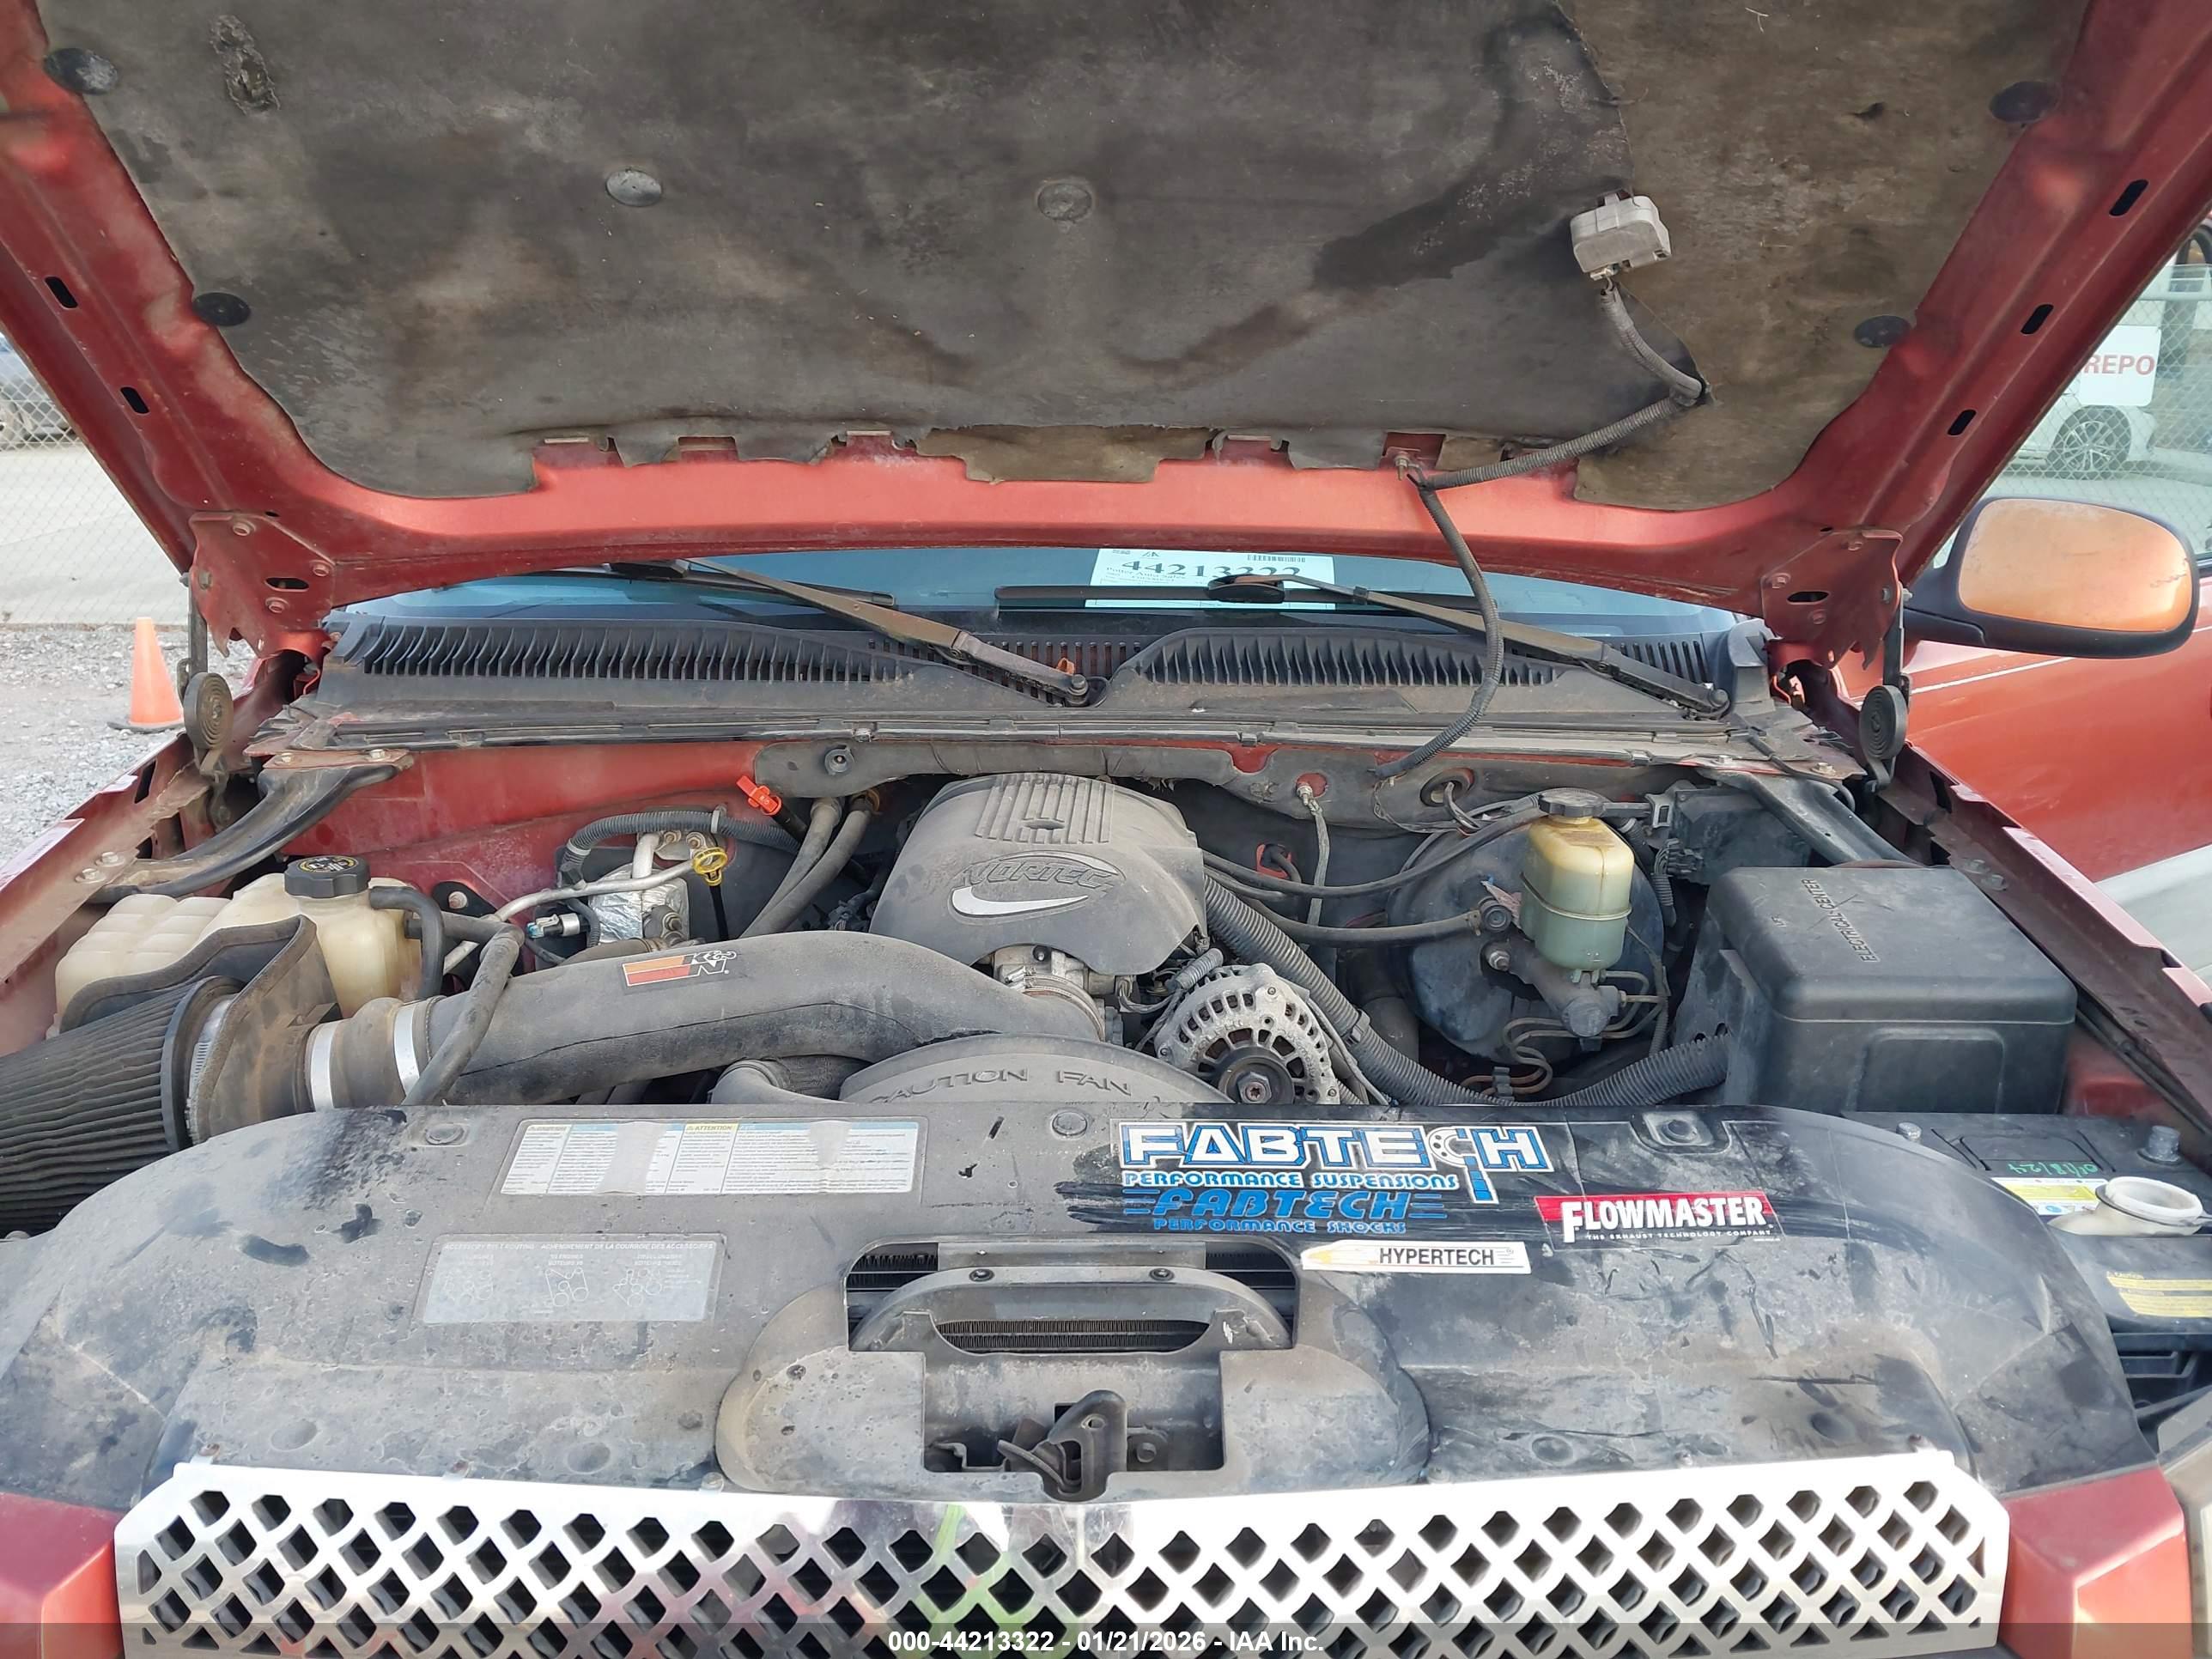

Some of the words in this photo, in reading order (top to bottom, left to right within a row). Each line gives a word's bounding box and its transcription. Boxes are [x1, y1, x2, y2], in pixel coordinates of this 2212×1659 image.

[2083, 355, 2155, 375] REPO
[1801, 878, 1837, 910] CENTER
[1826, 912, 1879, 963] ELECTRICAL
[1056, 1070, 1132, 1097] FAN
[1119, 1121, 1554, 1204] FABTECH
[1121, 1170, 1303, 1188] PERFORMANCE
[1311, 1173, 1460, 1191] SUSPENSIONS
[1150, 1188, 1412, 1219] FABTECH
[1153, 1218, 1316, 1233] PERFORMANCE
[1327, 1220, 1407, 1234] SHOCKS
[1561, 1196, 1768, 1243] FLOWMASTER
[1379, 1246, 1495, 1266] HYPERTECH
